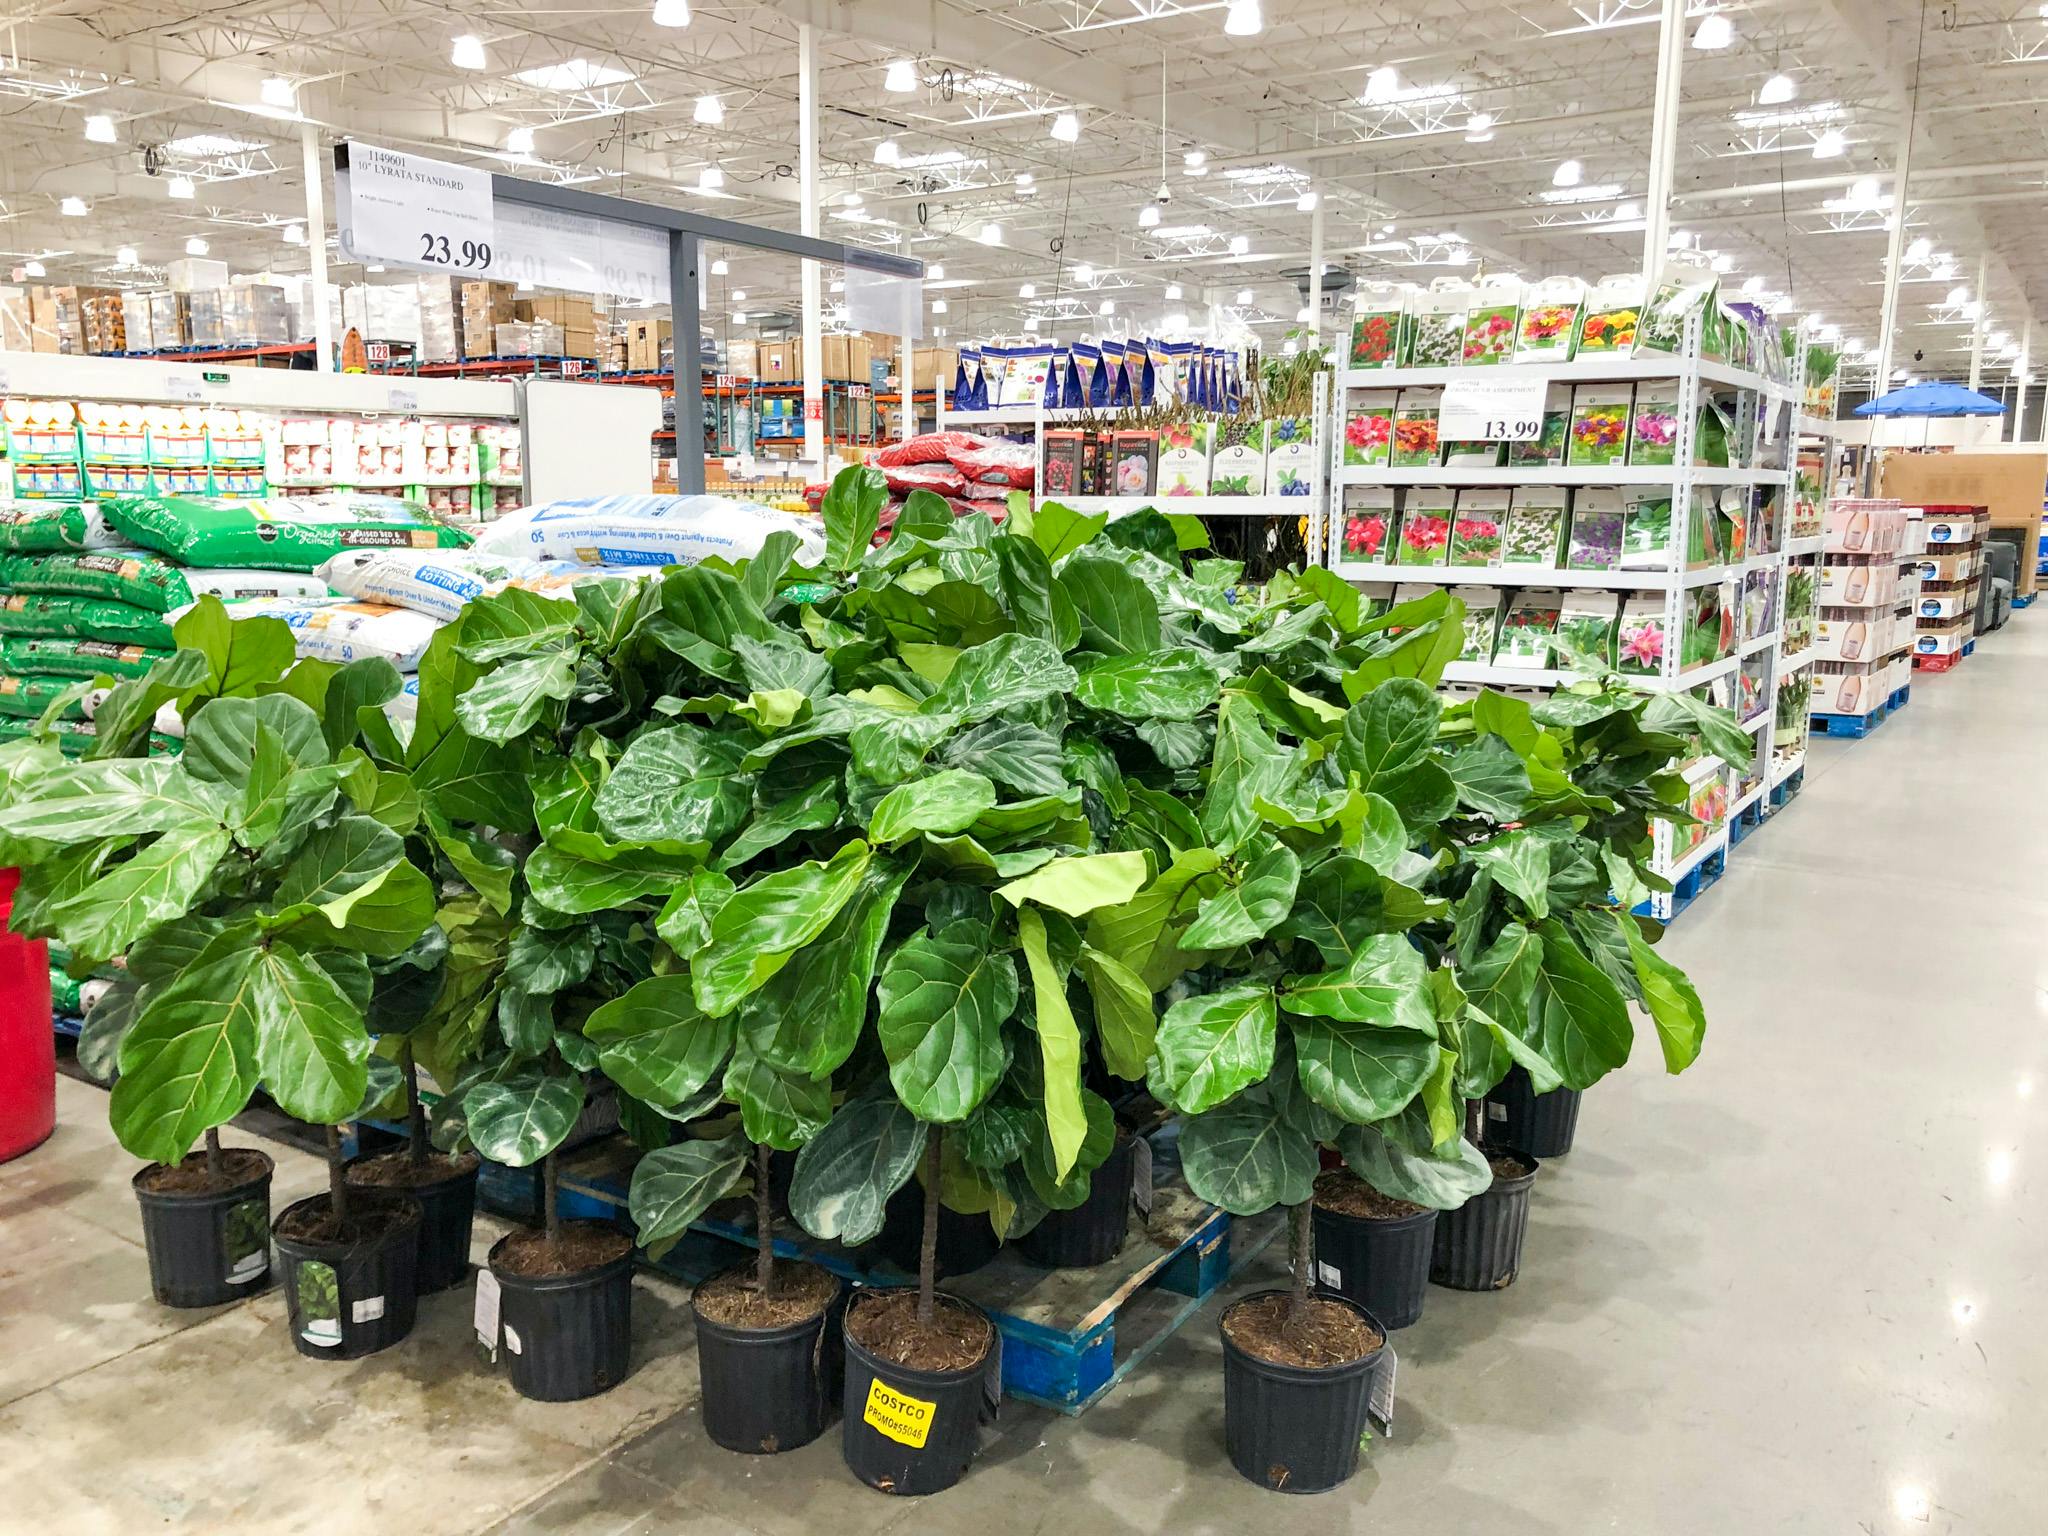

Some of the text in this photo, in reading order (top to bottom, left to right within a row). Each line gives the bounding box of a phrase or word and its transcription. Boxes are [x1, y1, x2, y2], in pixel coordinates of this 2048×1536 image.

[369, 150, 406, 167] 1149601
[374, 164, 413, 181] LYRATA
[415, 173, 464, 191] STANDARD
[420, 233, 492, 270] 23.99
[371, 346, 388, 359] 128
[564, 361, 580, 374] 126
[719, 375, 734, 386] 124
[850, 386, 864, 396] 122
[1484, 421, 1538, 439] 13.99
[531, 530, 545, 544] 50
[609, 529, 636, 541] Watering
[638, 532, 657, 541] Under
[658, 532, 663, 540] &
[664, 532, 680, 541] Over
[681, 532, 705, 543] Against
[706, 536, 733, 546] Protects
[602, 549, 622, 559] MIX
[419, 570, 462, 593] POTTING
[342, 645, 353, 659] 50
[874, 1387, 925, 1420] COSTCO
[867, 1405, 923, 1439] PROMO#55046
